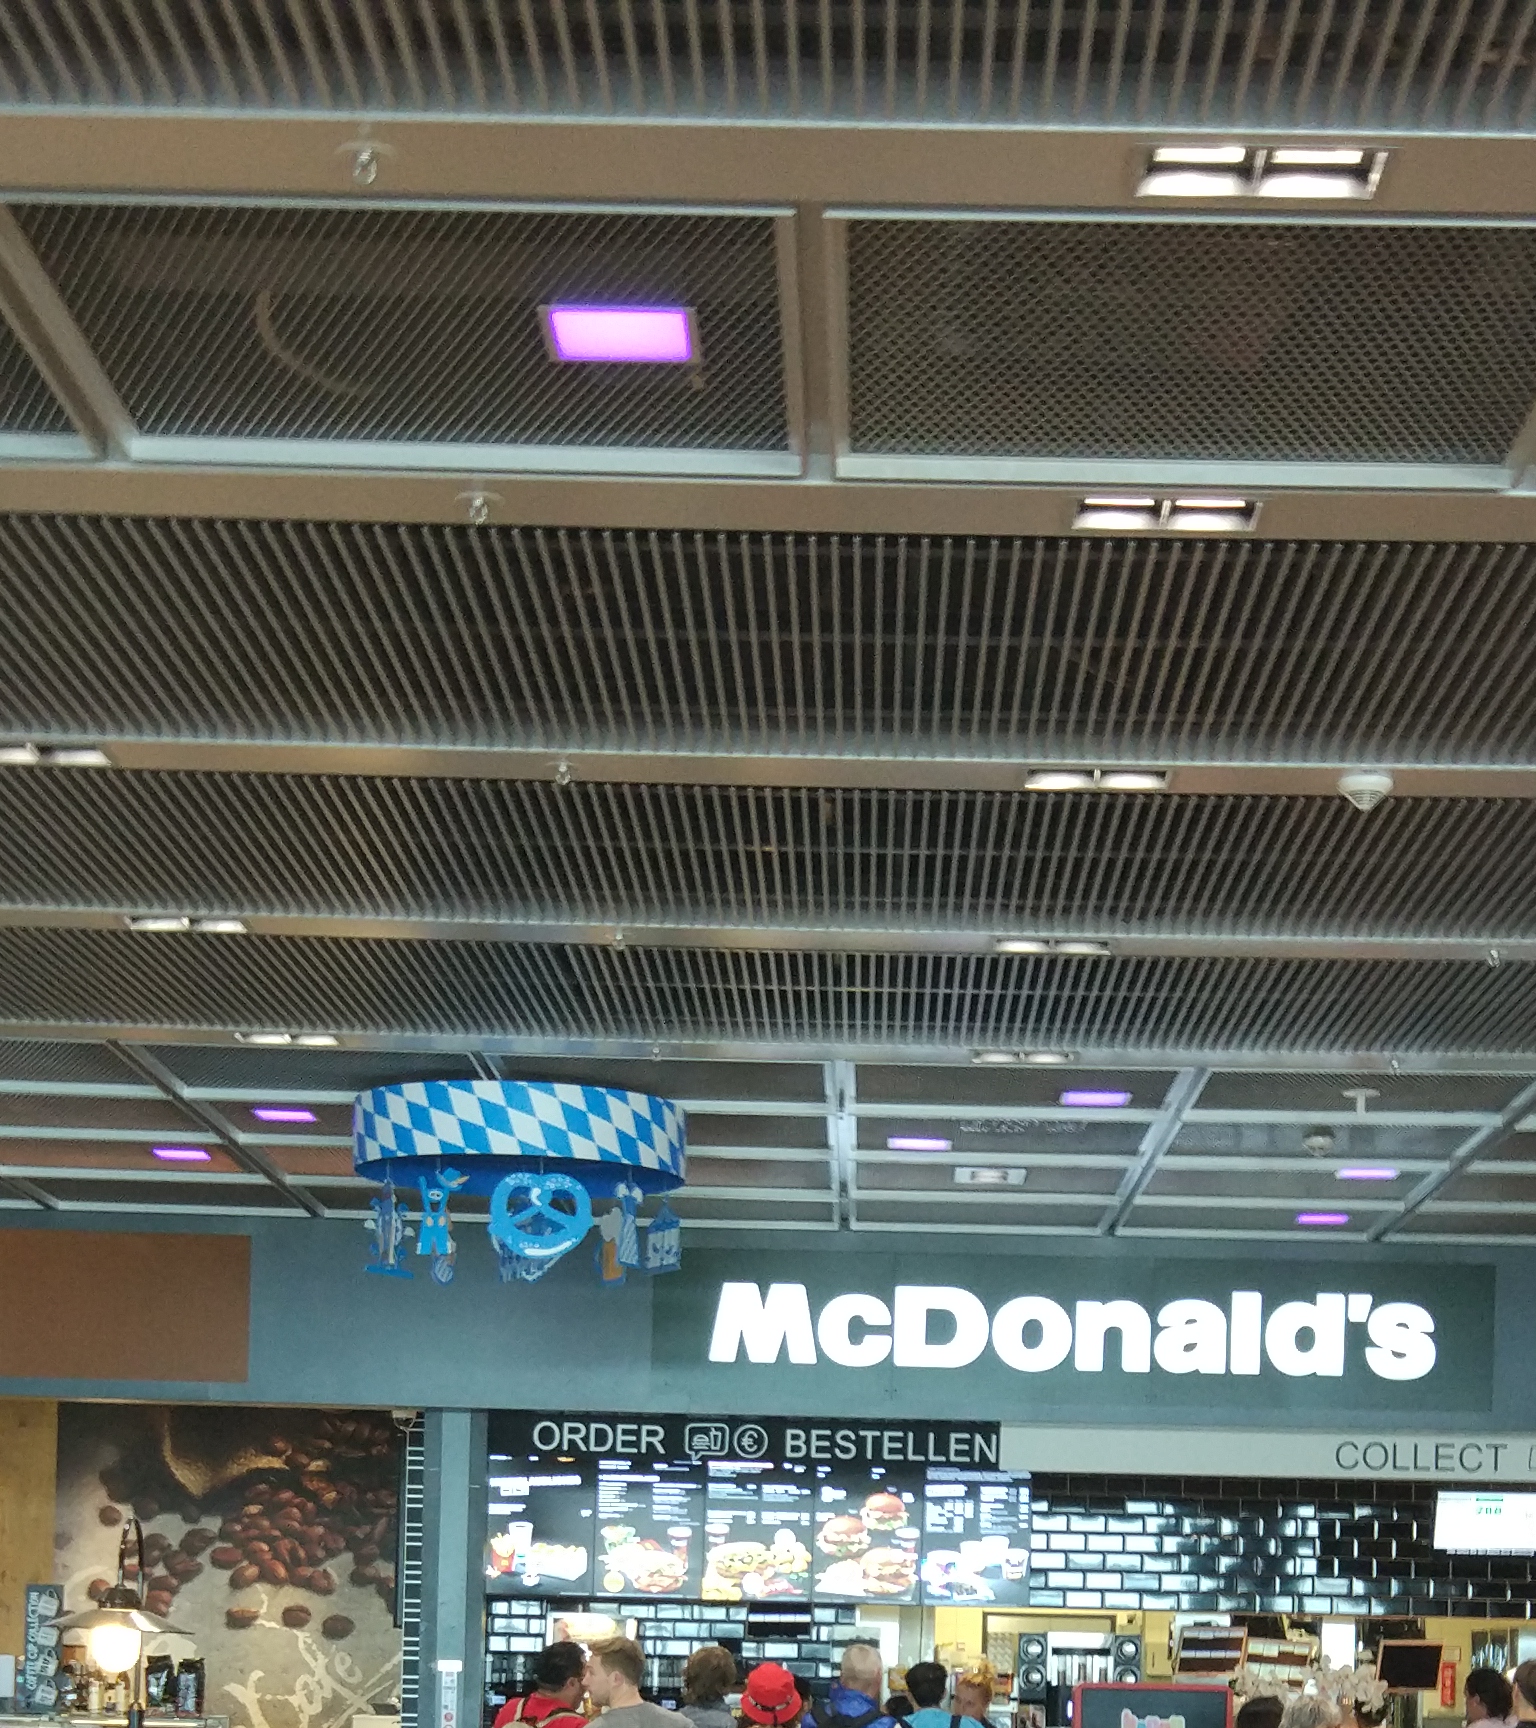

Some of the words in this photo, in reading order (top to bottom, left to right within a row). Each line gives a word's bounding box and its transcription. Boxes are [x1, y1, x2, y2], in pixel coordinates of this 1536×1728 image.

[708, 1282, 1437, 1380] McDonald's
[532, 1420, 666, 1455] ORDER
[784, 1428, 999, 1463] BESTELLEN
[1334, 1441, 1508, 1474] COLLECT
